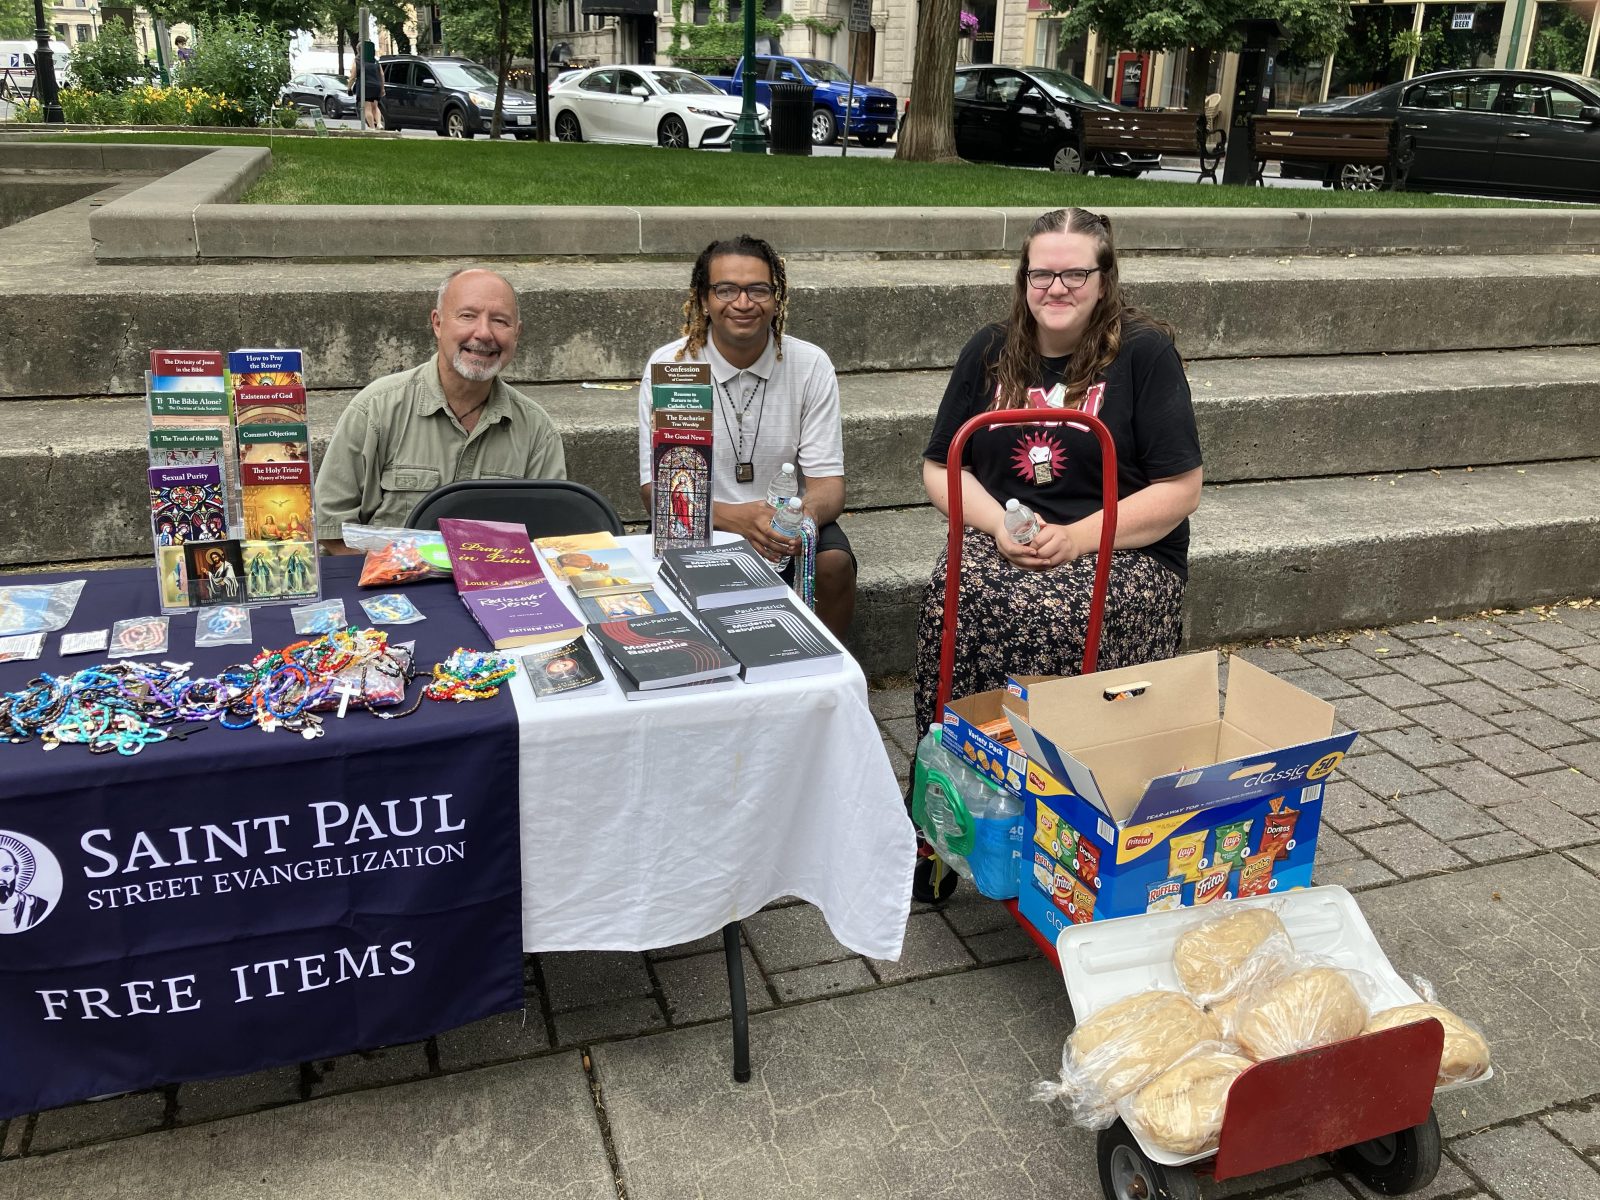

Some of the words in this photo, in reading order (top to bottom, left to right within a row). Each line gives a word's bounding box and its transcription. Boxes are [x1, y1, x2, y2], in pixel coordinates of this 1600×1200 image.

[1268, 57, 1274, 72] P
[186, 472, 208, 481] Purity
[265, 467, 281, 475] Holy
[282, 466, 303, 475] Trinity
[460, 542, 507, 557] Pray
[696, 546, 744, 555] Paul-Patrick
[485, 553, 531, 564] Latin
[477, 592, 547, 607] Rediscover
[497, 600, 540, 611] Jesus
[734, 603, 786, 615] Paul-Patrick
[630, 616, 679, 628] Paul-Patrick
[726, 624, 776, 634] Babylonia
[732, 619, 772, 628] Moderni
[623, 639, 674, 651] Moderni
[627, 642, 689, 656] Babylonia
[944, 714, 958, 724] Lance
[968, 729, 987, 746] Variety
[989, 742, 1003, 756] Pack
[1315, 754, 1336, 772] 50
[1244, 764, 1309, 788] classic
[1146, 807, 1184, 820] TEAR-AWAY
[1185, 804, 1200, 812] TOP
[80, 814, 289, 879] SAINT
[308, 794, 467, 848] PAUL
[1009, 826, 1024, 835] 40
[1267, 824, 1290, 834] Doritos
[1079, 845, 1097, 864] Doritos
[1035, 852, 1054, 873] RUFFLES
[1243, 857, 1271, 879] Cheetos
[88, 876, 202, 911] STREET
[214, 841, 467, 894] EVANGELIZATION
[1055, 875, 1072, 891] Fritos
[1149, 882, 1180, 901] RUFFLES
[1199, 871, 1225, 897] Fritos
[36, 974, 202, 1022] FREE
[230, 940, 416, 1004] ITEMS
